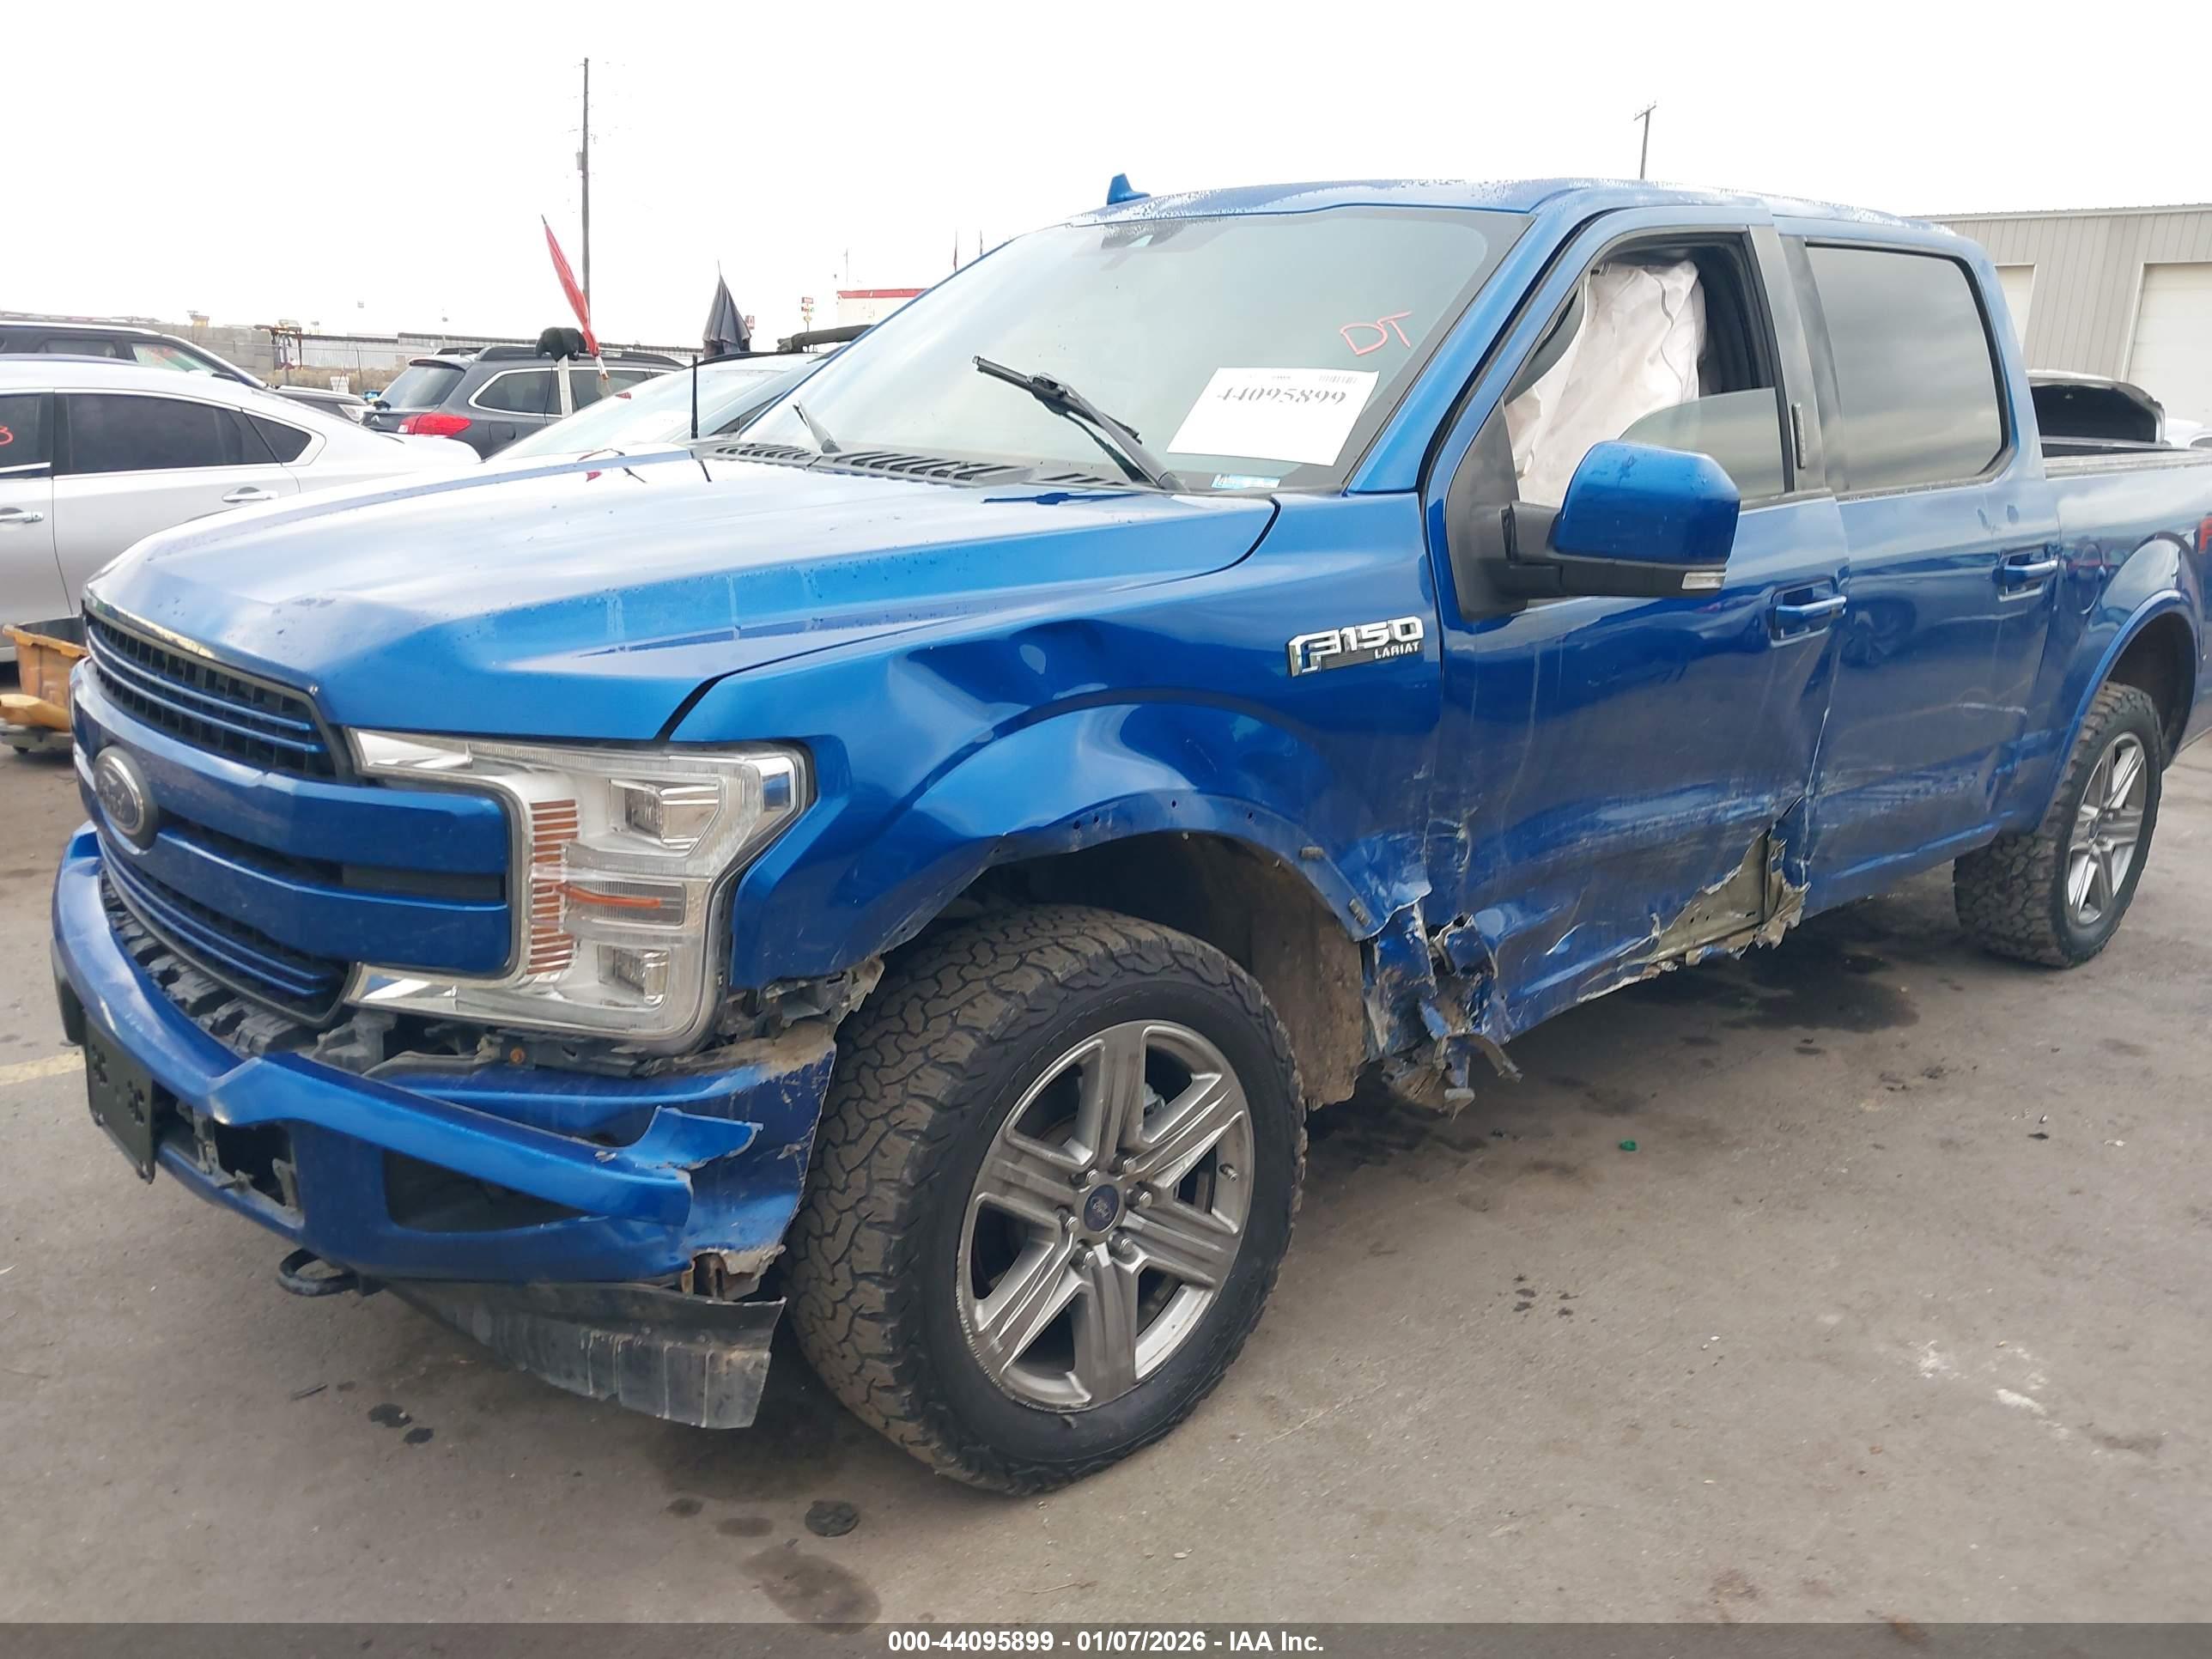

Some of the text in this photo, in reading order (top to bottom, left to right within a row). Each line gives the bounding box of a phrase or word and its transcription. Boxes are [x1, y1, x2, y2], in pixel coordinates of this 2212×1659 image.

[1339, 310, 1413, 356] DT
[1218, 386, 1346, 405] 44095899
[1374, 641, 1420, 659] LARIAT
